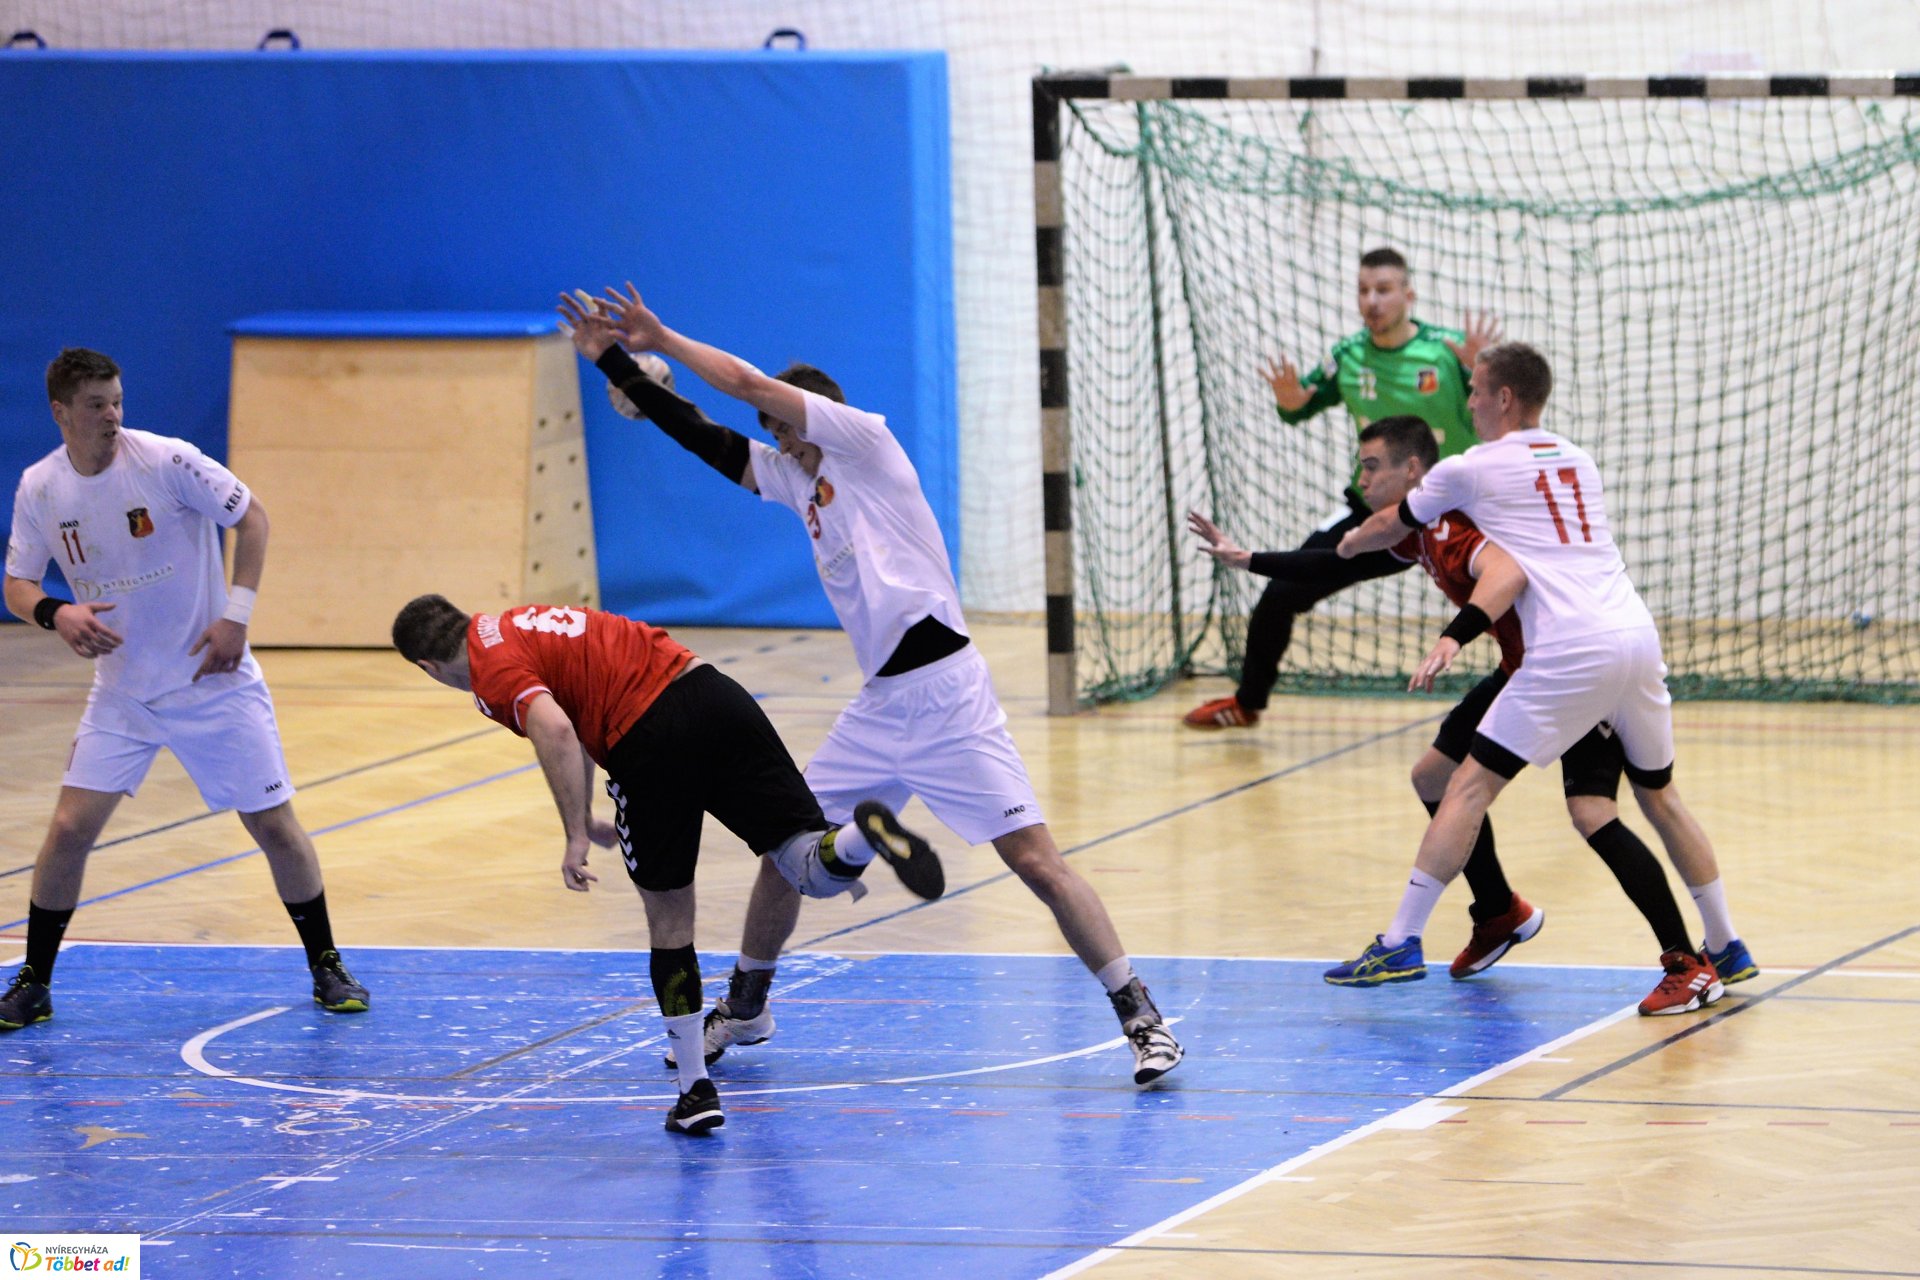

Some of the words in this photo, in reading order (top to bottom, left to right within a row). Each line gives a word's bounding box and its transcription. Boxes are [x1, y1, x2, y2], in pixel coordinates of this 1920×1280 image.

[1535, 467, 1592, 544] 17
[59, 520, 79, 529] JAKO
[62, 530, 86, 565] 11
[1003, 805, 1025, 818] JAKO
